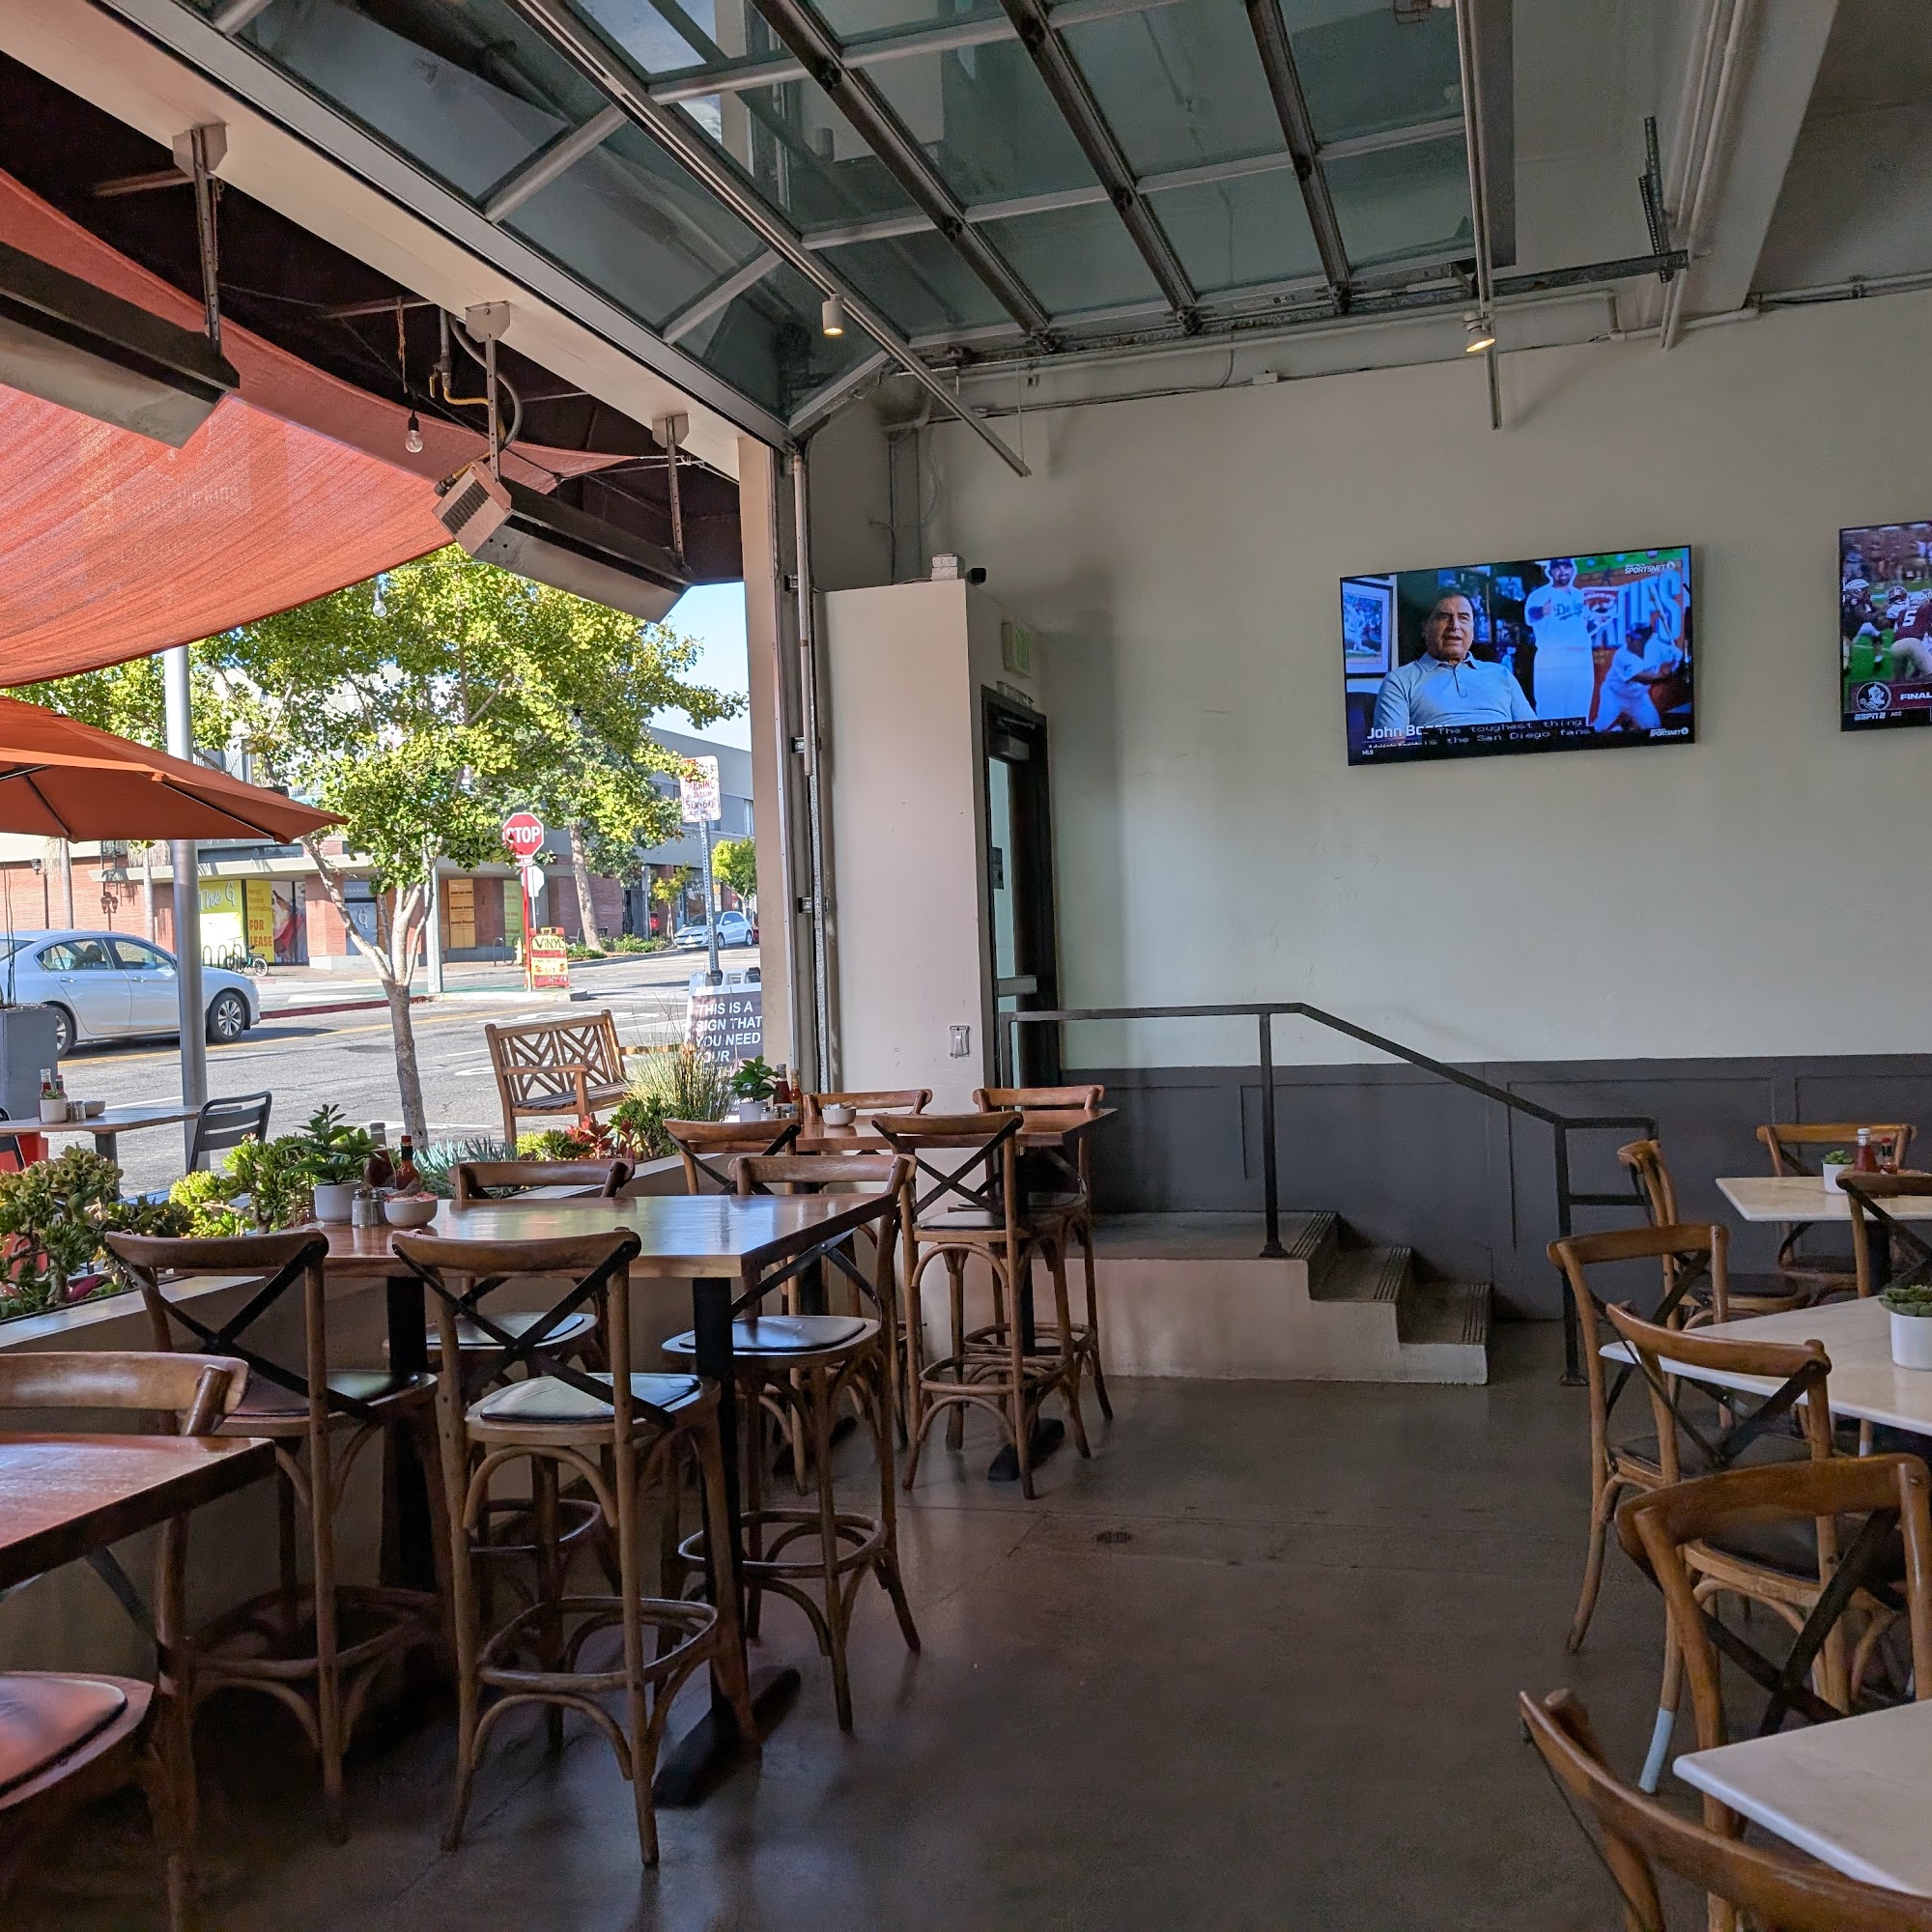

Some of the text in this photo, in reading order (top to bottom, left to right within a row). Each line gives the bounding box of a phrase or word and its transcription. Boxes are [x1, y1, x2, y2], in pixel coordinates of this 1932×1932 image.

[1624, 564, 1665, 575] SPORTSNET
[1900, 692, 1932, 700] FINAL
[1367, 725, 1402, 740] John
[1470, 722, 1533, 733] toughest
[1544, 719, 1583, 728] thing
[1510, 731, 1550, 741] Diego
[249, 920, 265, 930] FOR
[250, 936, 272, 948] LEASE
[696, 1001, 753, 1016] THIS IS A
[696, 1016, 762, 1033] SIGN THAT
[696, 1032, 761, 1048] YOU NEED
